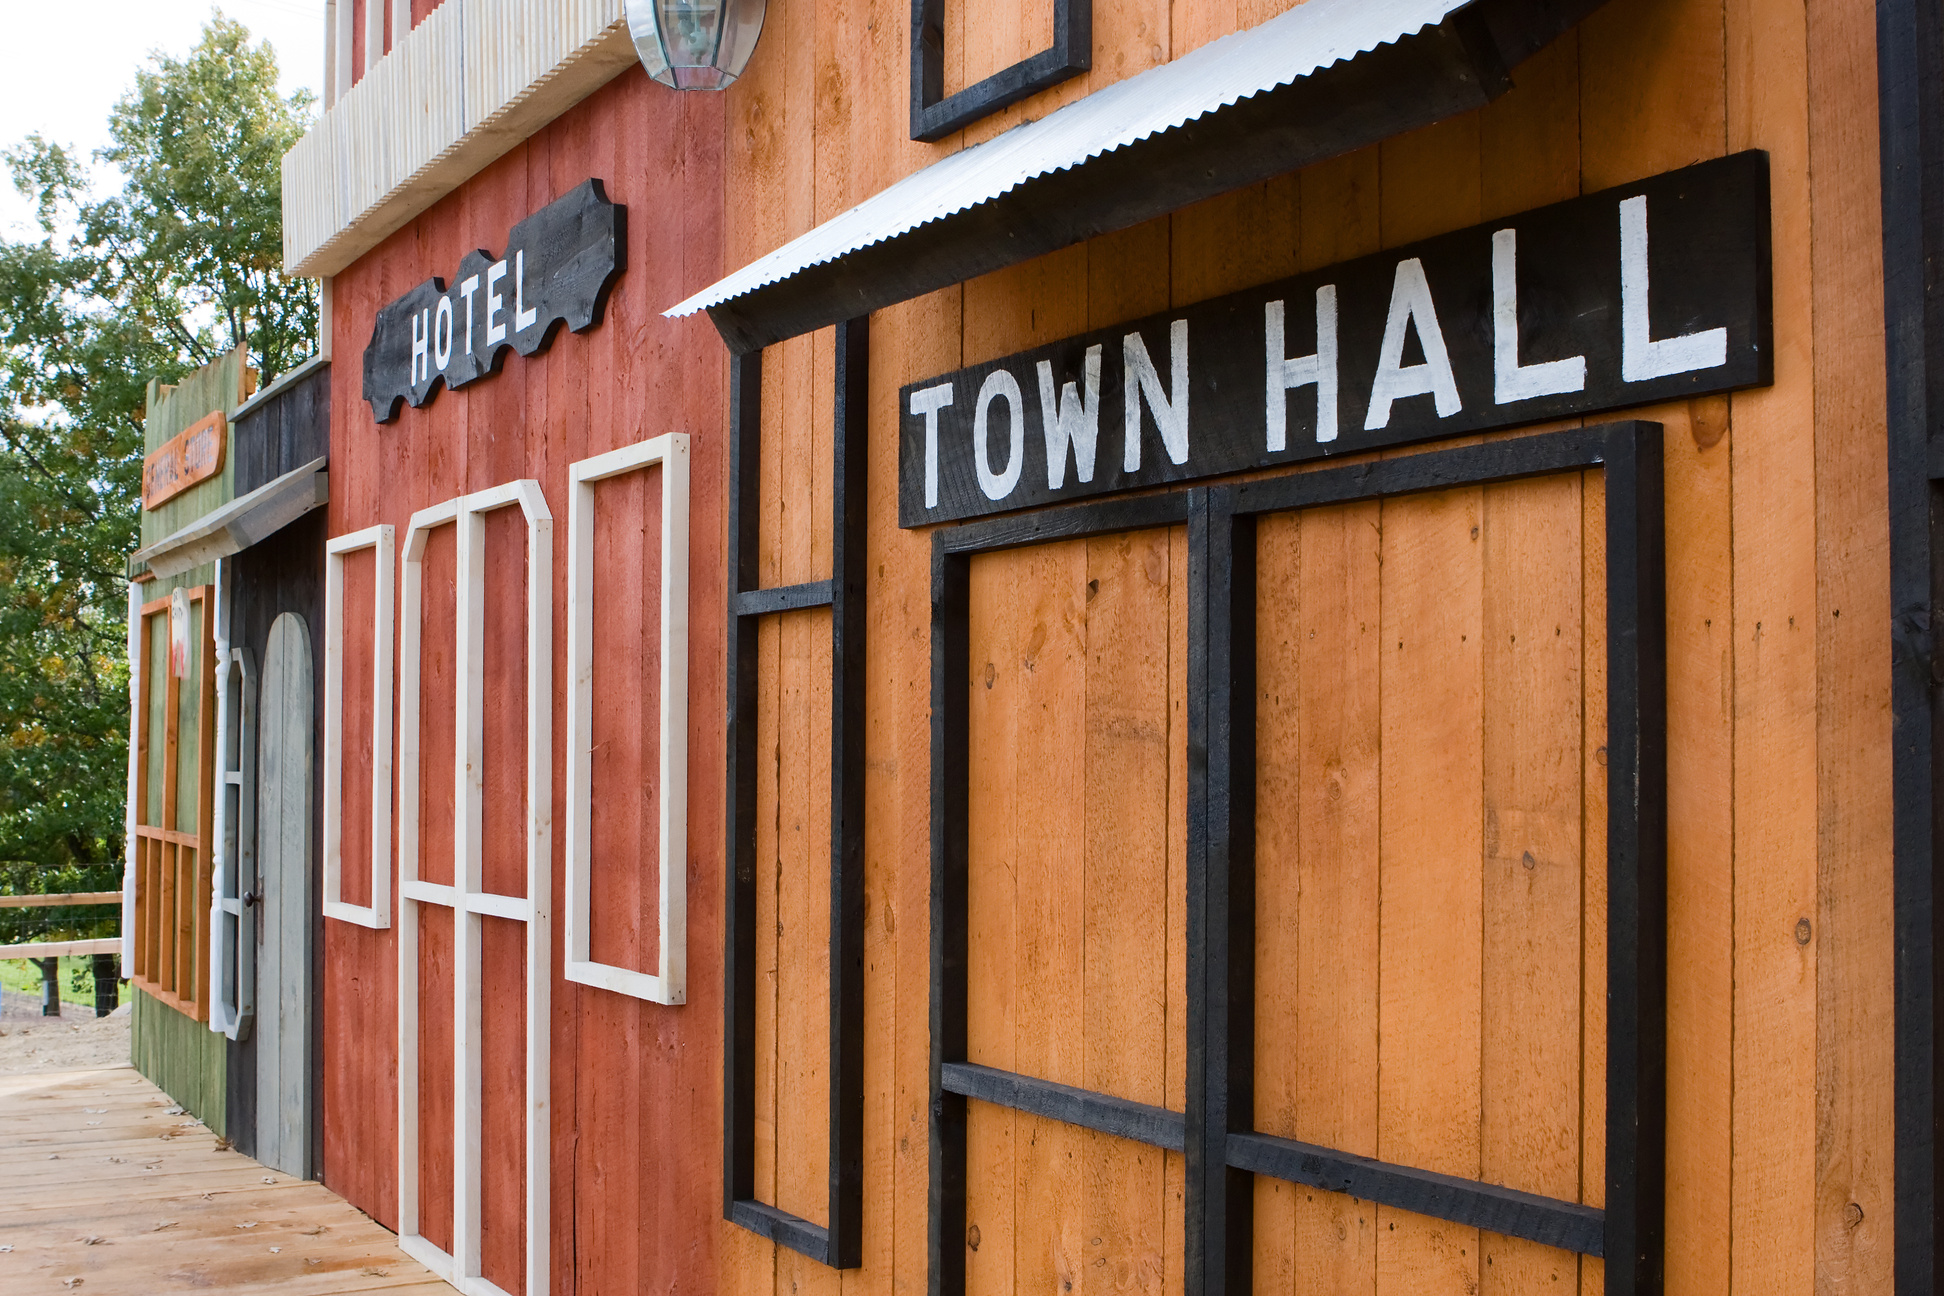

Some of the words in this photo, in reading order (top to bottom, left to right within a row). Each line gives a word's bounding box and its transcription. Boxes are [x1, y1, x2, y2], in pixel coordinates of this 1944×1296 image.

[411, 249, 537, 387] HOTEL
[910, 318, 1189, 510] TOWN
[1265, 194, 1728, 452] HALL
[184, 425, 214, 476] STORE
